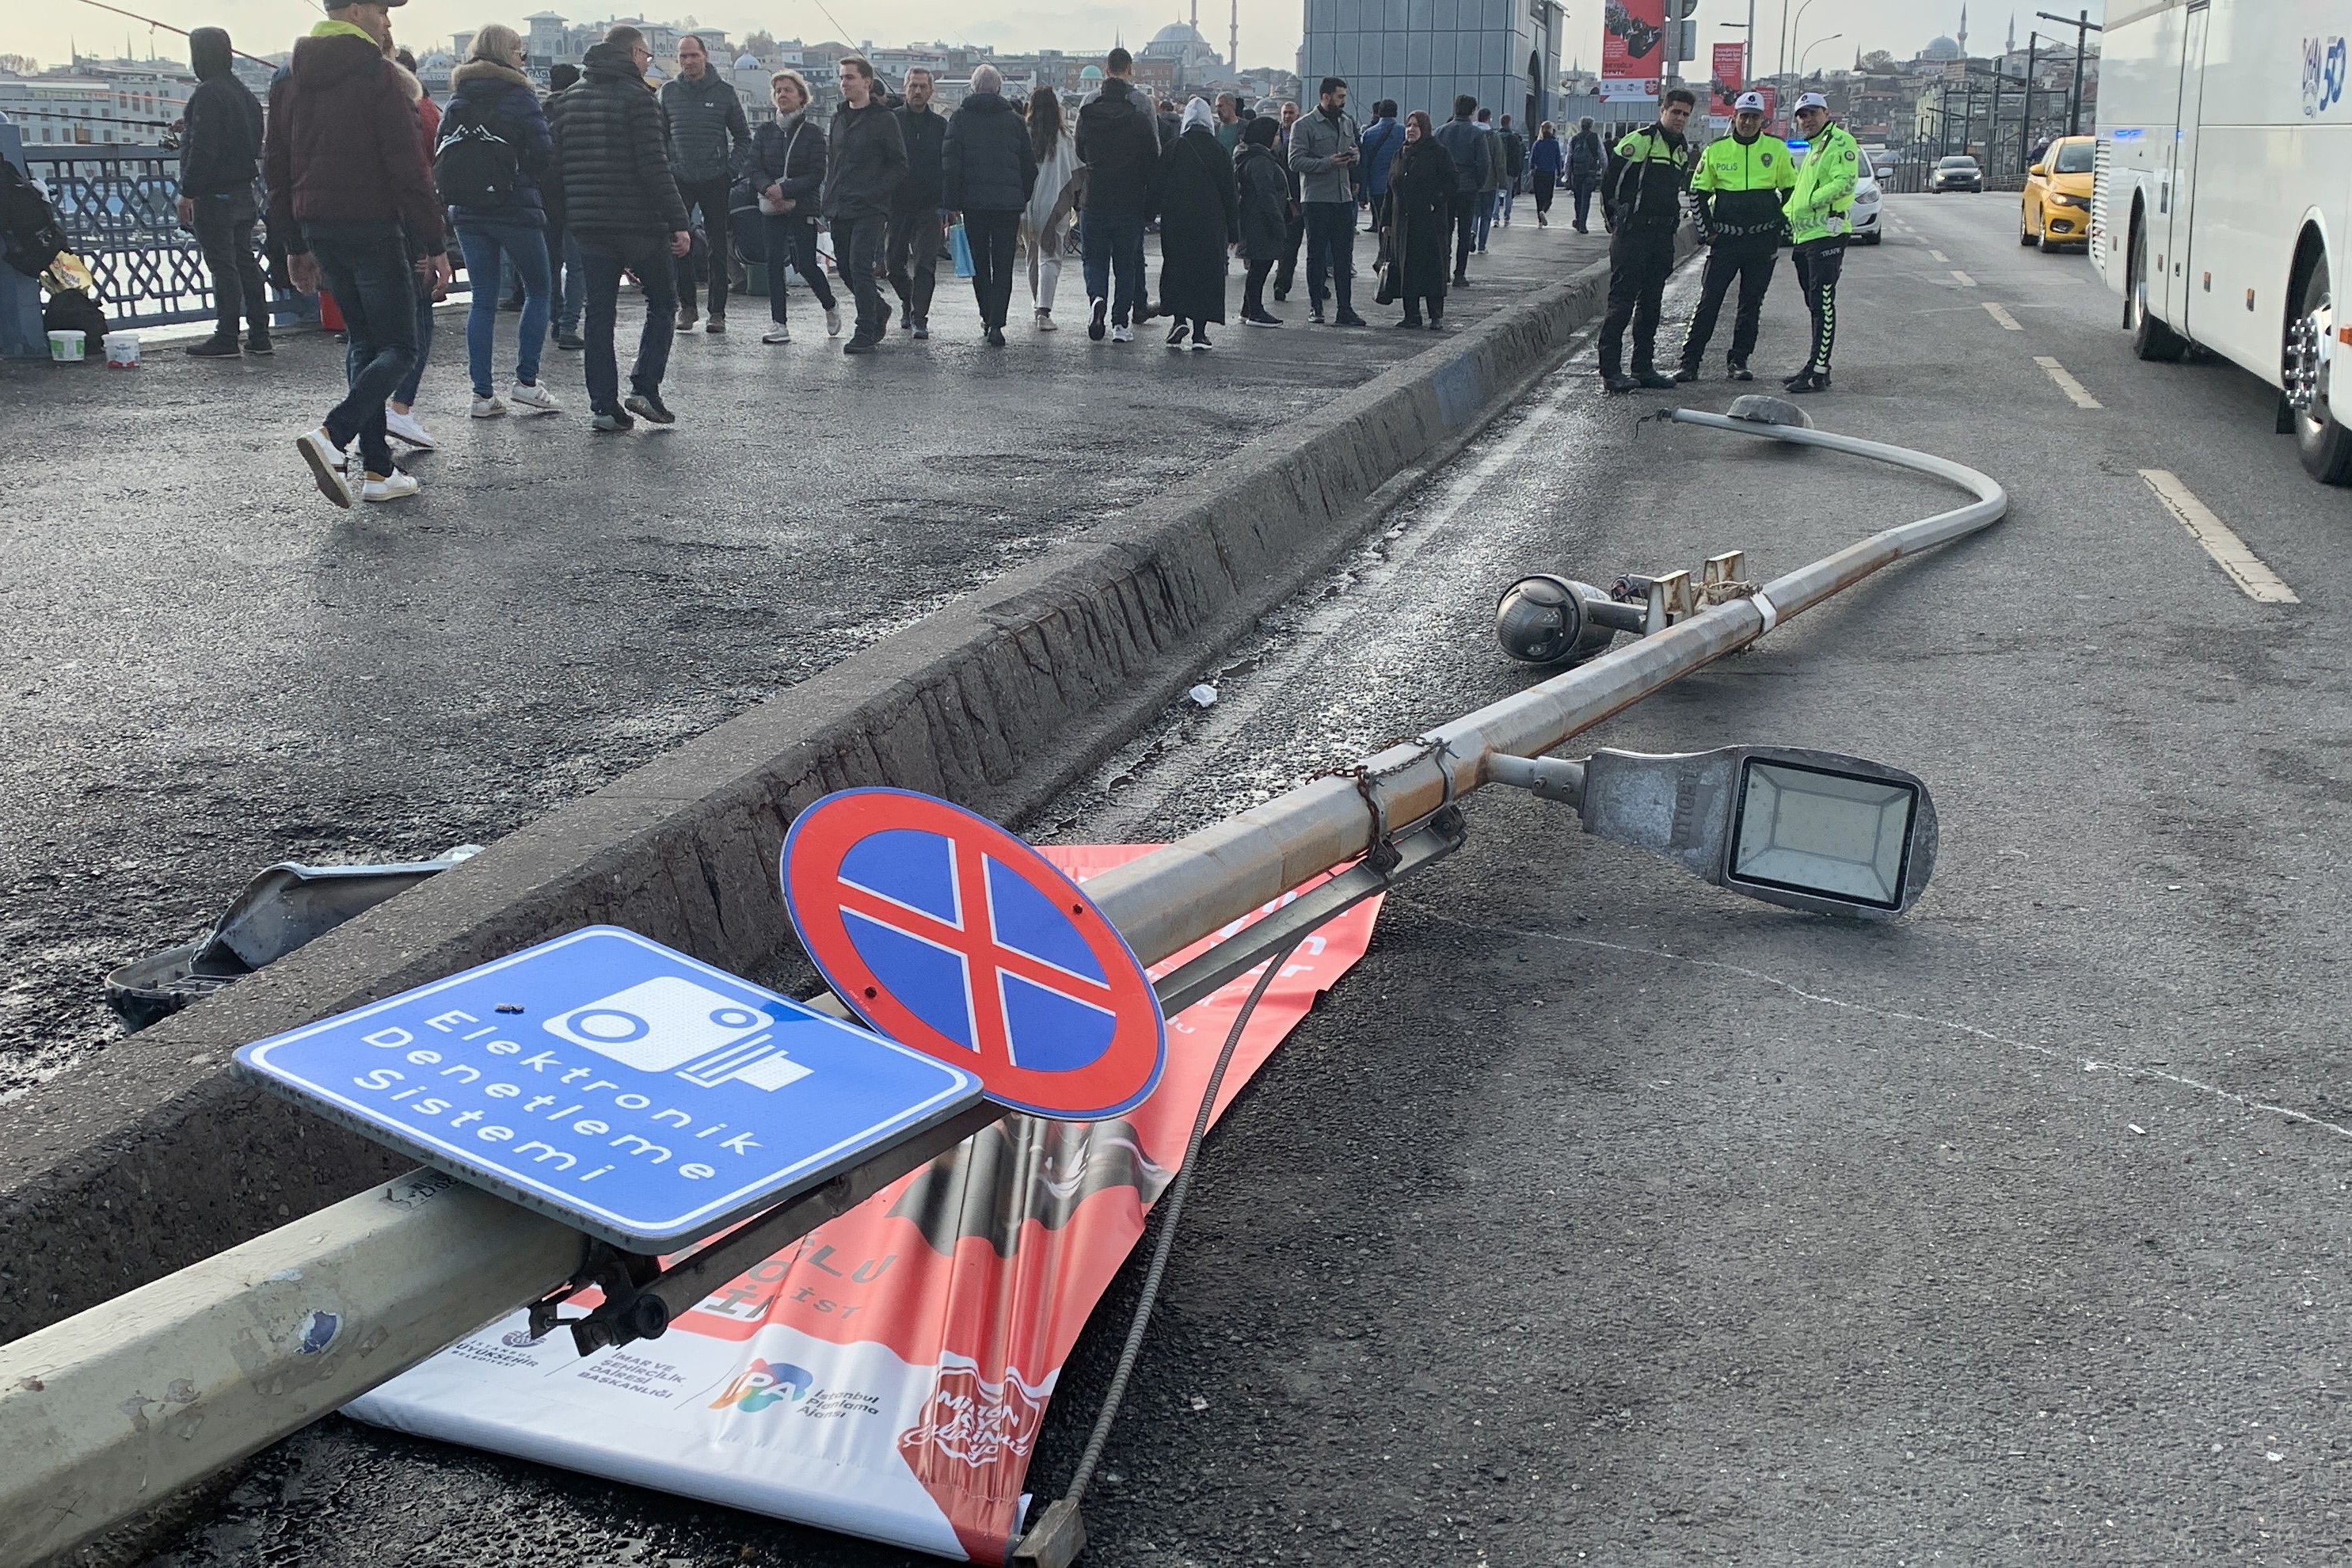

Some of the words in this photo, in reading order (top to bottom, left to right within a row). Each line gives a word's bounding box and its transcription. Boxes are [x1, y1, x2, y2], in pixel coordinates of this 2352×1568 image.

[424, 1009, 763, 1156] Elektronik
[360, 1026, 716, 1180] Denetleme
[353, 1069, 616, 1182] Sistemi
[455, 1343, 539, 1368] ÜYÜKŞEHİR
[611, 1351, 653, 1367] İMAR
[655, 1363, 676, 1372] VE
[588, 1365, 653, 1384] DAİRESİ
[600, 1359, 687, 1383] ŞEHİRCİLİK
[577, 1372, 674, 1399] BAŞKANLIĞI
[813, 1389, 881, 1404] İstanbul
[796, 1406, 847, 1418] Ajansı
[805, 1398, 880, 1415] Planlama
